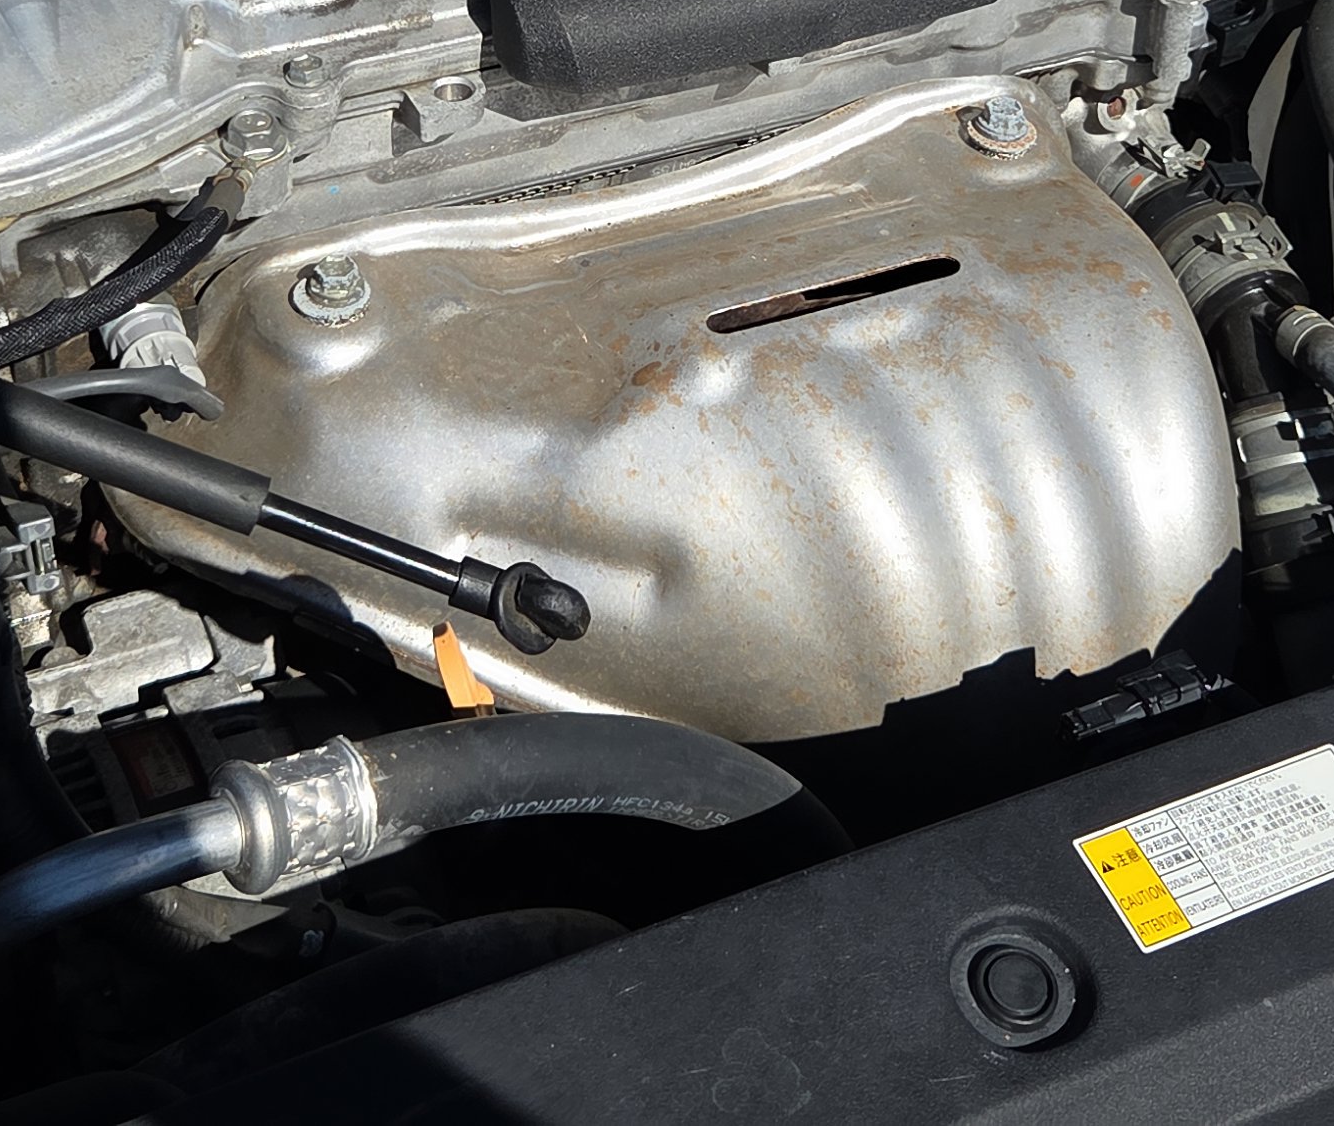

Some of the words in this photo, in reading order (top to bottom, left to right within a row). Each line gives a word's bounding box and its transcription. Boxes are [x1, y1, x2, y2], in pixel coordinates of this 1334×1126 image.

[1204, 856, 1218, 866] TO
[1217, 846, 1243, 861] AVOID
[1242, 831, 1282, 851] PERSONAL
[1310, 811, 1332, 825] KEEP
[1209, 860, 1232, 873] AWAY
[1231, 850, 1255, 864] FROM
[1278, 833, 1299, 846] FANS
[1298, 826, 1317, 838] MAY
[1110, 846, 1142, 868] 注意
[1213, 867, 1234, 880] TIME
[1234, 853, 1270, 872] IGNITION
[1268, 849, 1280, 859] IS
[1165, 874, 1193, 891] COOLING
[1189, 867, 1208, 881] FANS
[1118, 882, 1167, 911] CAUTION
[1183, 893, 1225, 917] VENTILATEURS
[1135, 908, 1184, 937] ATTENTION
